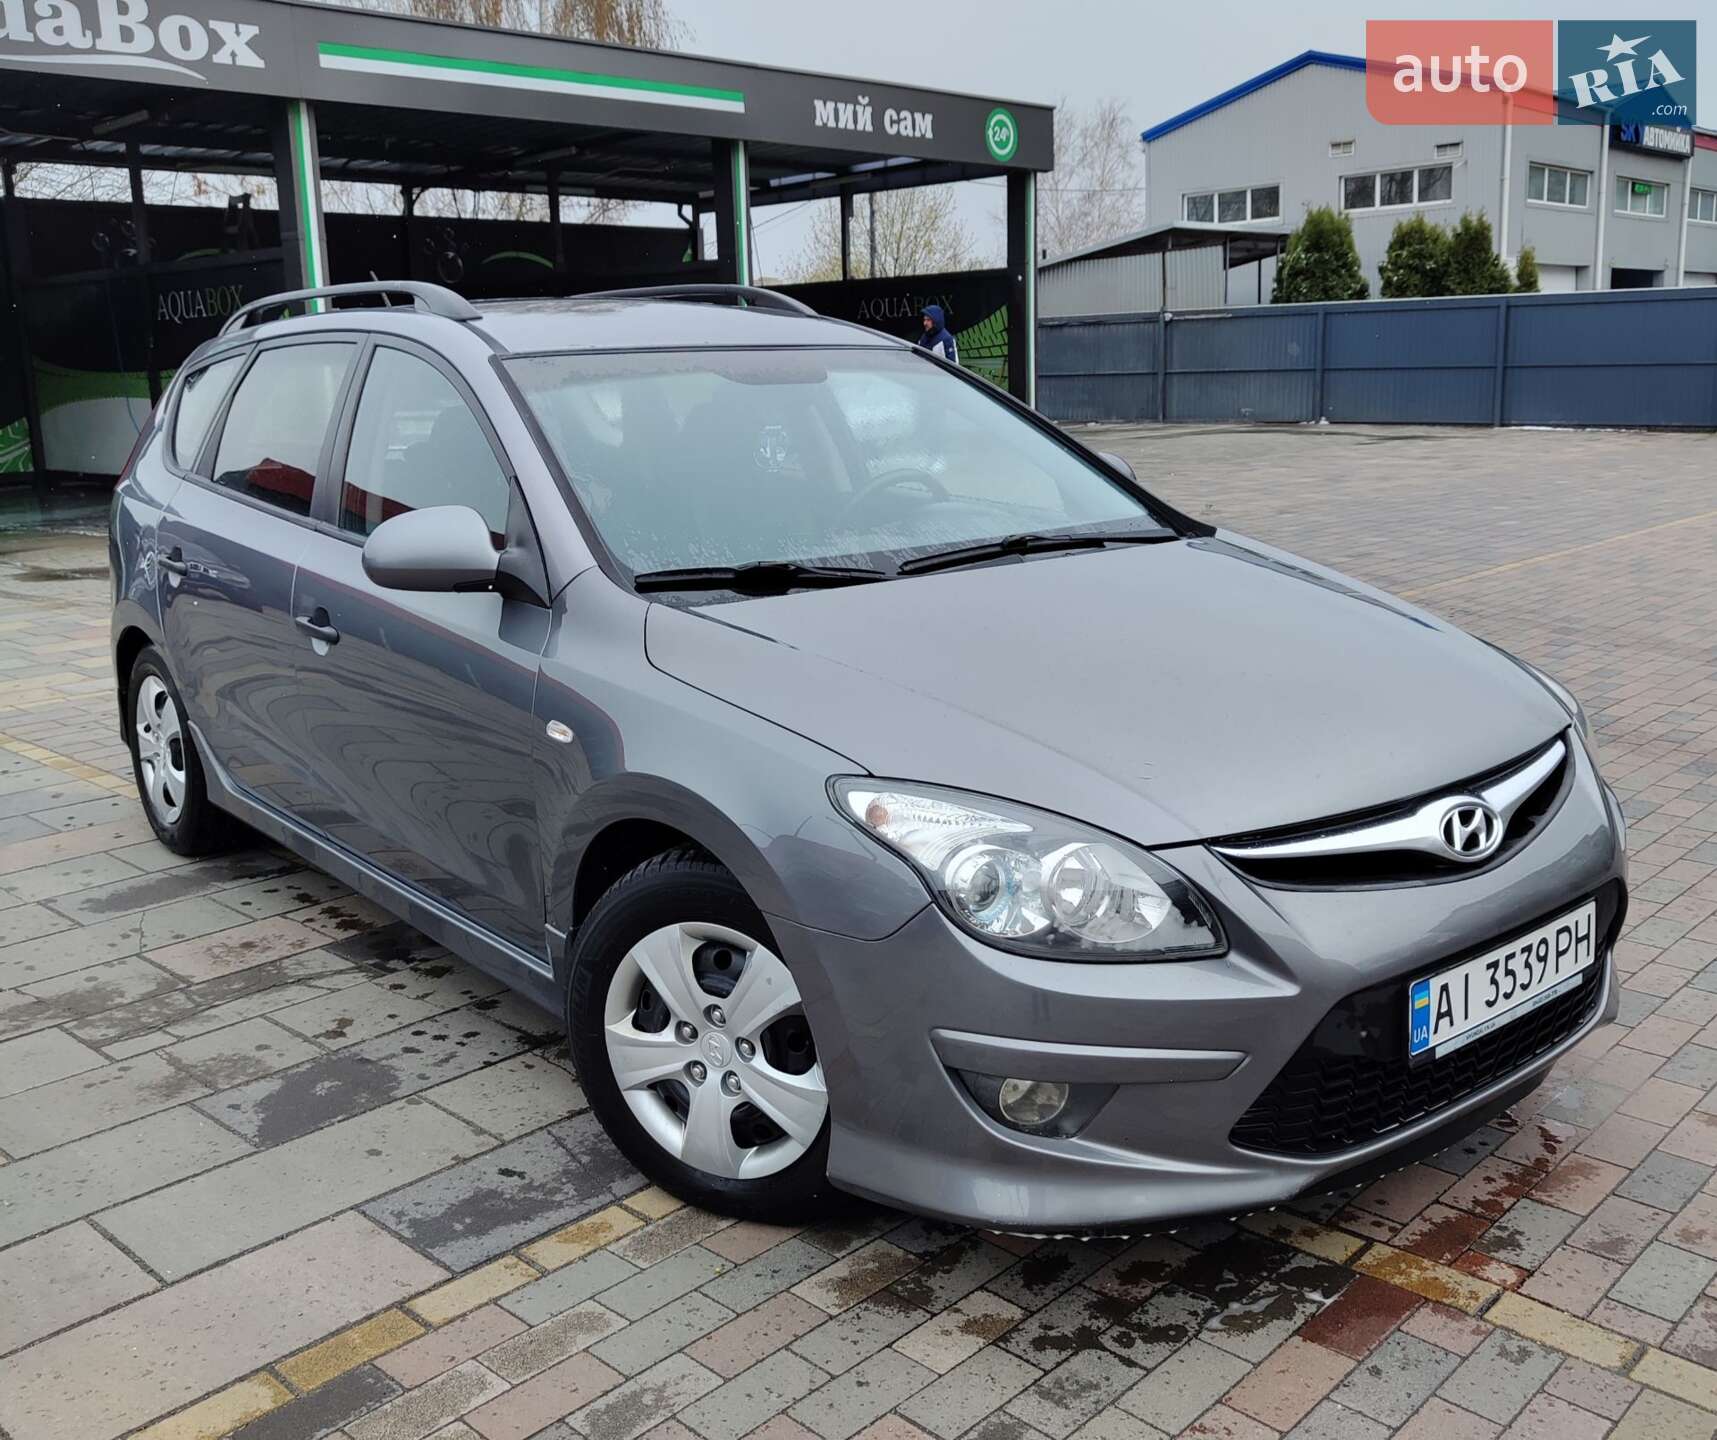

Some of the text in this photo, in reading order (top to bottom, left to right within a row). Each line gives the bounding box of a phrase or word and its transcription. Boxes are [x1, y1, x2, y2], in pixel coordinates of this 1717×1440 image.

[884, 108, 934, 139] сам
[1643, 126, 1691, 153] АВТОМИЙКА
[157, 285, 244, 324] AQUABOX
[1433, 913, 1592, 1035] AI 3539 PH
[1413, 1027, 1429, 1044] UA
